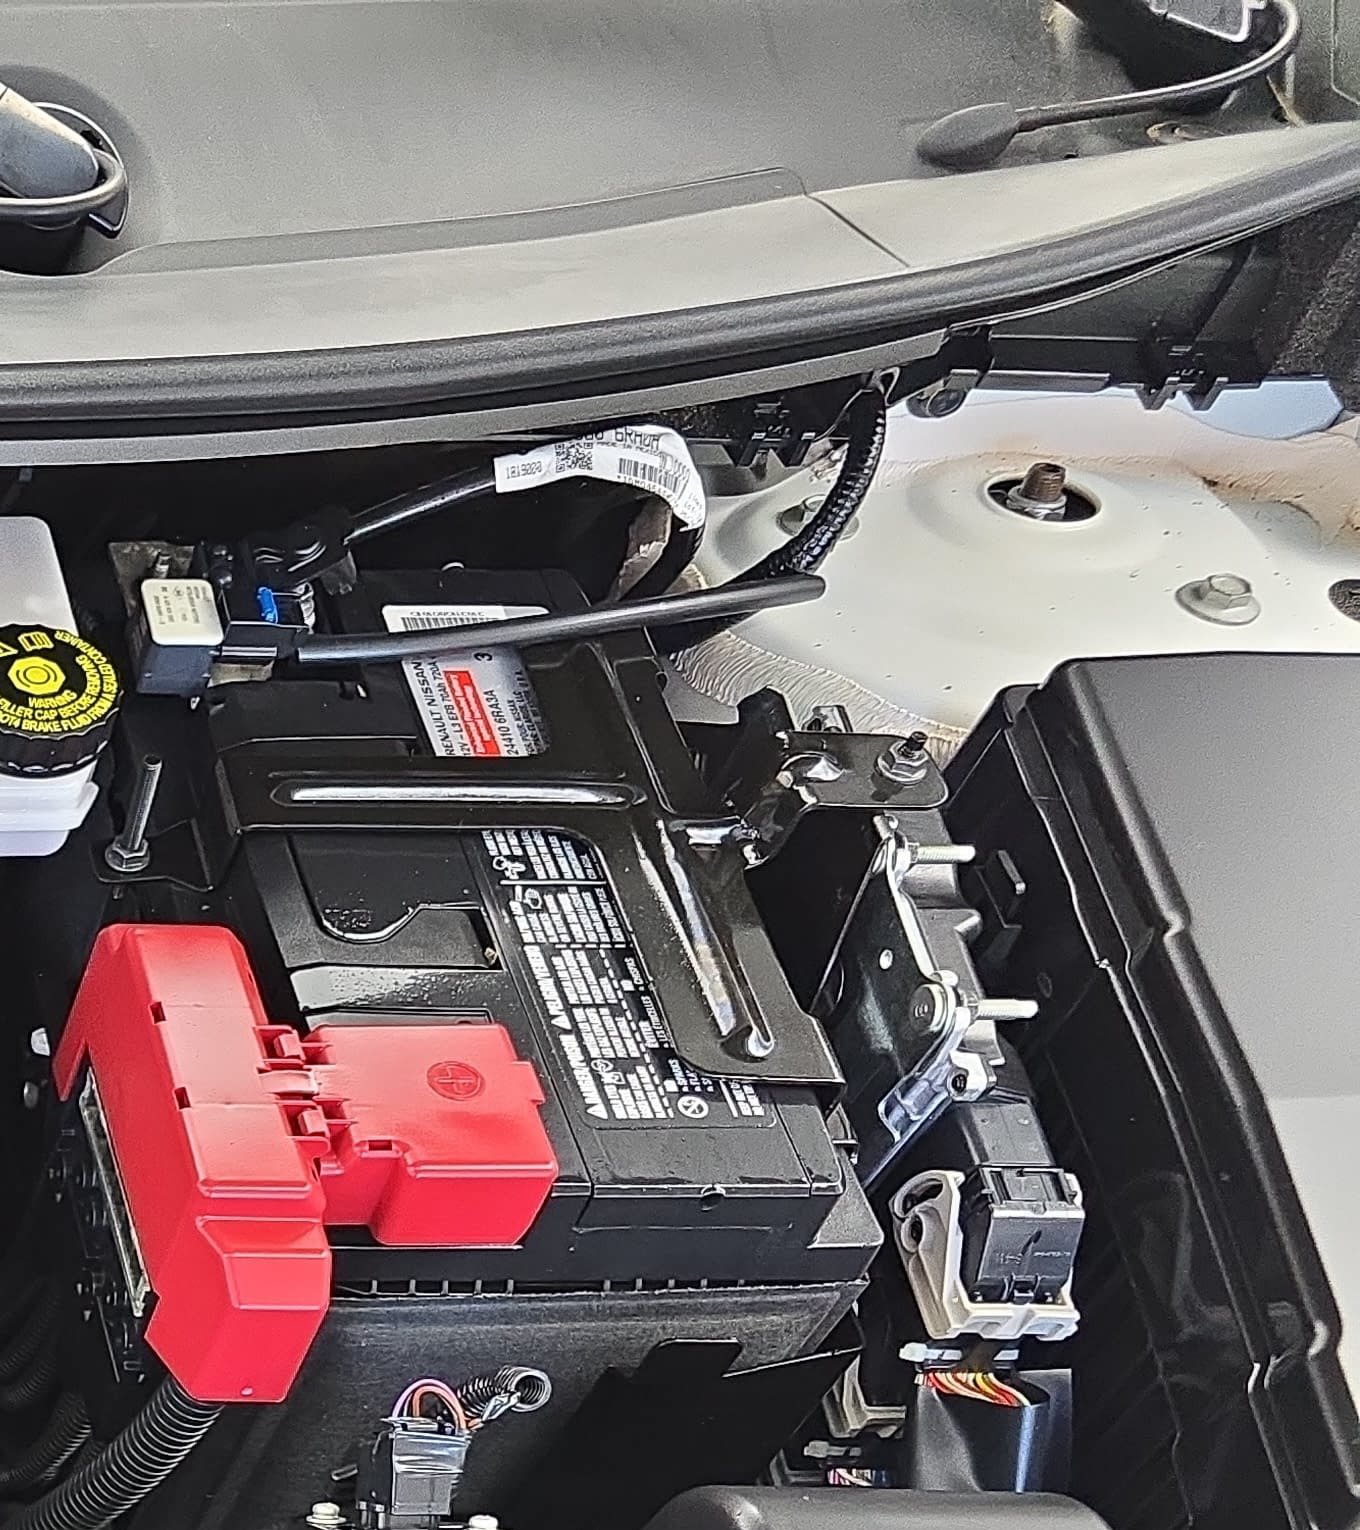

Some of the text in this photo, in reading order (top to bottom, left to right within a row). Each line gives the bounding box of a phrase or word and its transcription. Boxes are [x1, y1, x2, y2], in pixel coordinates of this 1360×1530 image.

[54, 630, 107, 664] CONTAINER
[474, 652, 492, 661] 3
[75, 654, 101, 697] REMOVING
[98, 662, 118, 693] SEALED
[28, 689, 77, 708] WARNING
[59, 692, 96, 718] BEFORE
[88, 697, 112, 720] FROM
[411, 661, 455, 756] RENAULT NISSAN
[22, 720, 61, 732] BRAKE
[34, 710, 58, 721] CAP
[61, 714, 93, 732] FLUID
[483, 689, 520, 755] 24410 6RA3A
